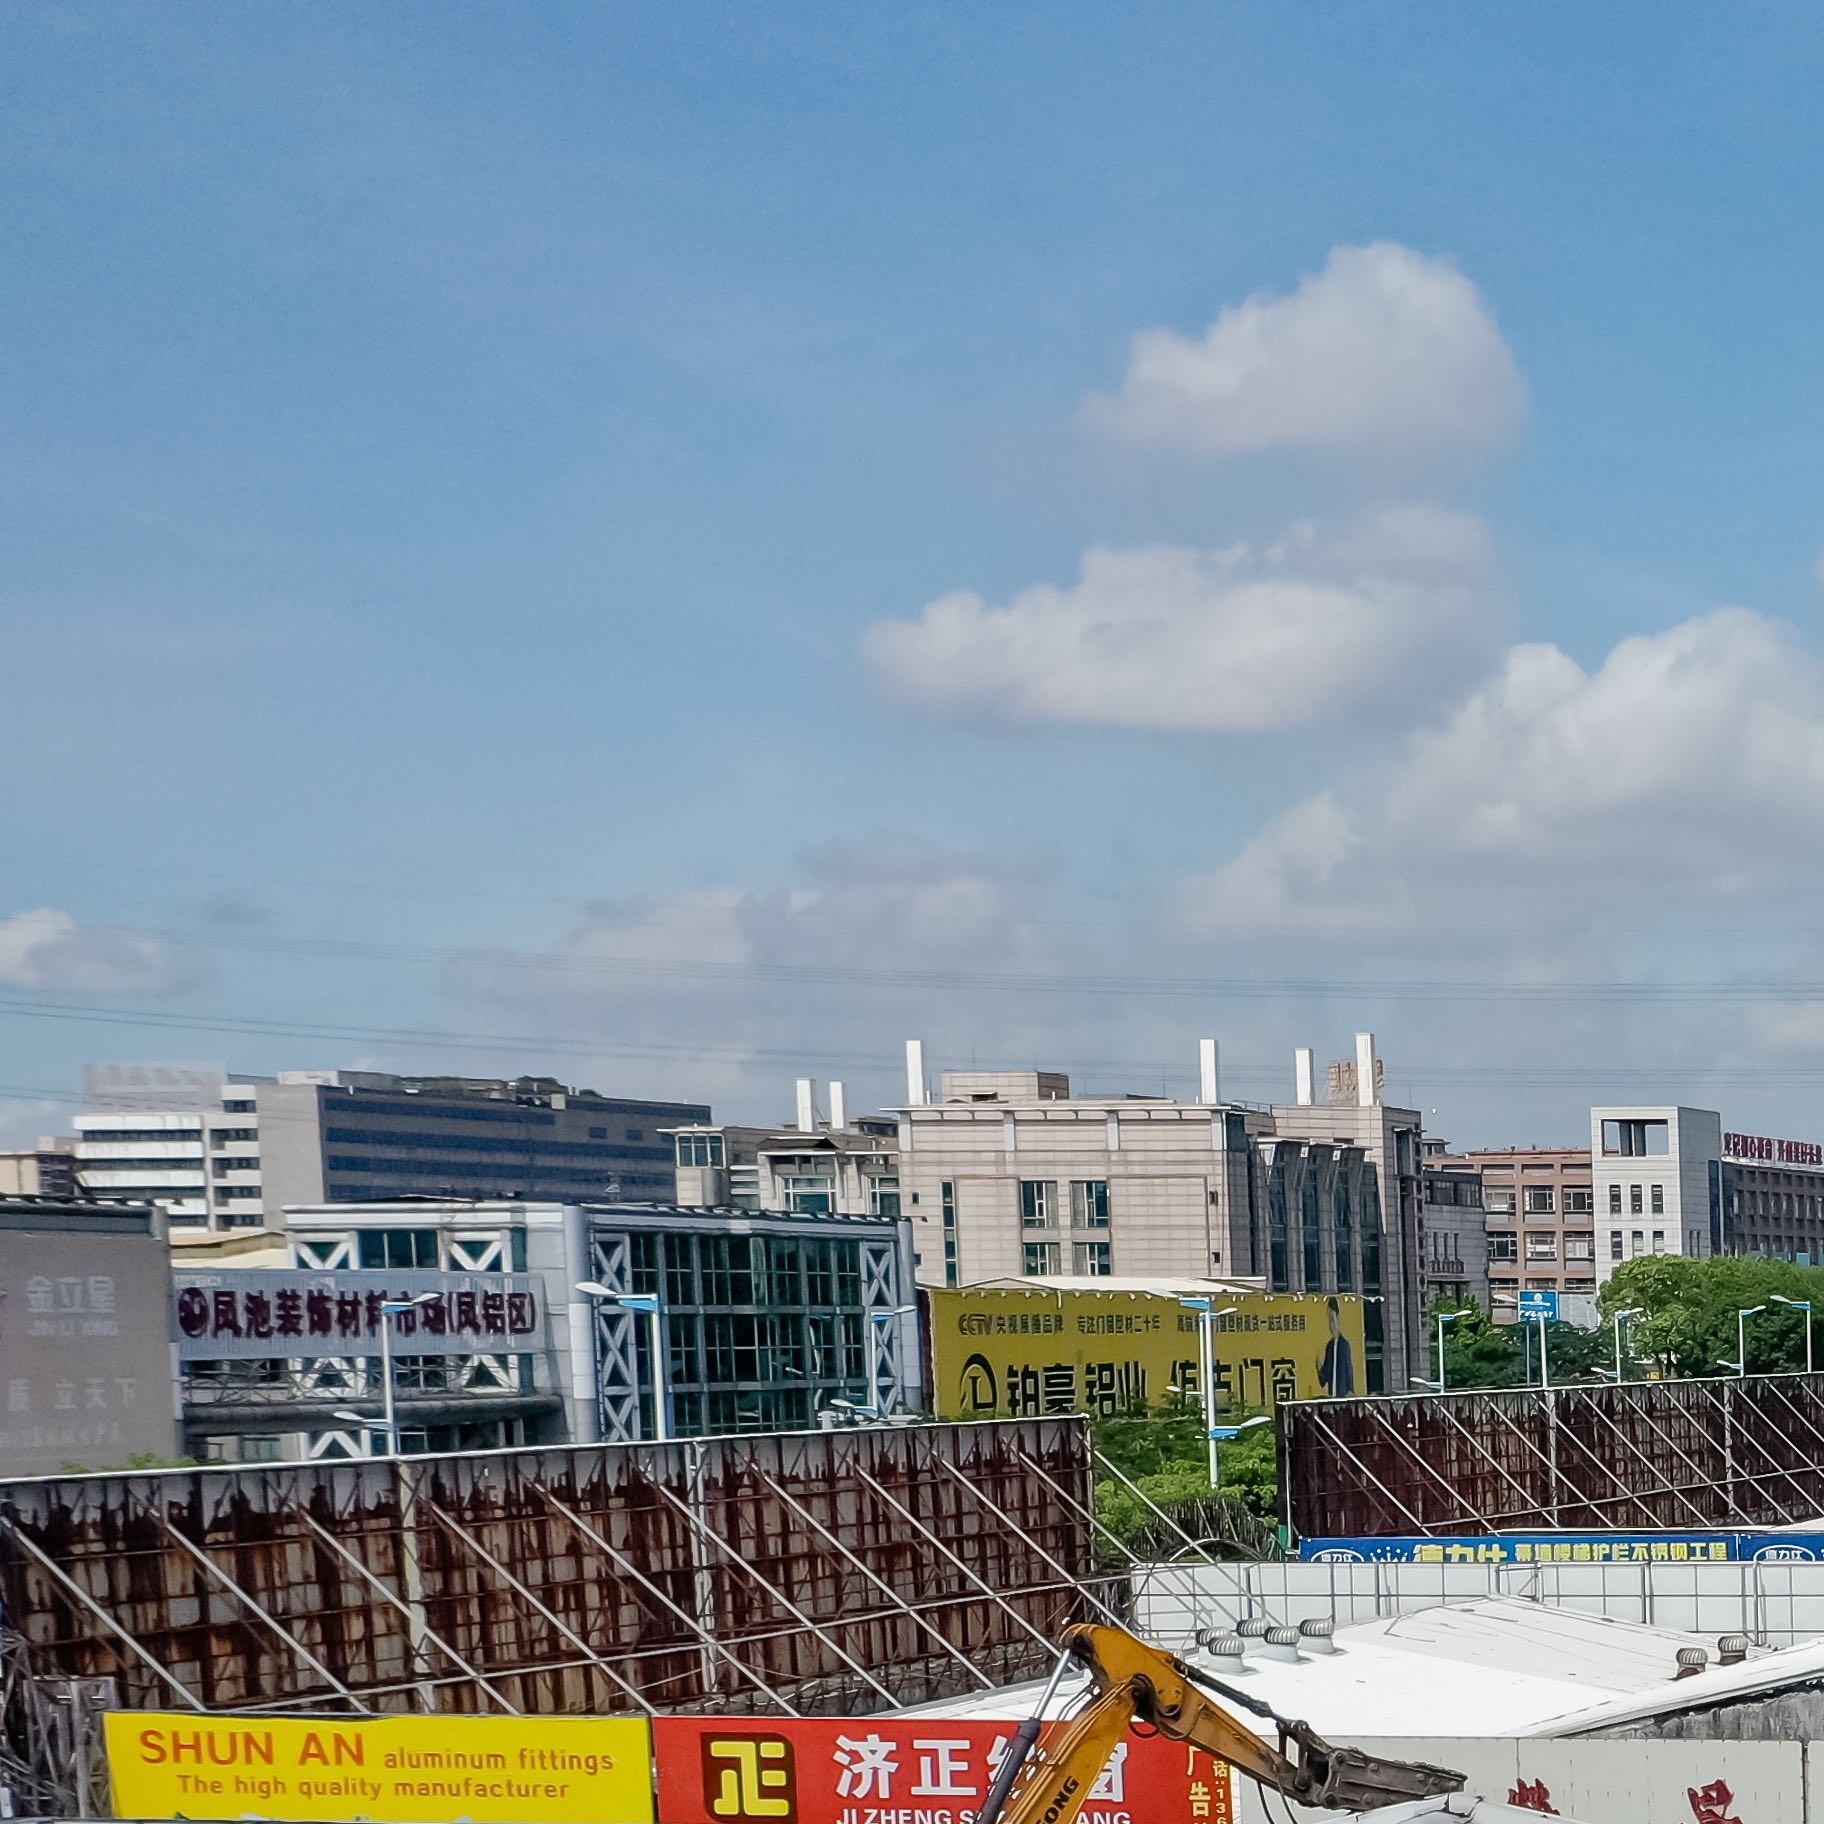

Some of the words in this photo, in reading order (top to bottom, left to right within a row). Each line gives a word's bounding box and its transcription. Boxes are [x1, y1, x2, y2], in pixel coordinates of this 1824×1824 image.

[140, 1730, 274, 1767] SHUN
[299, 1731, 365, 1766] AN
[384, 1745, 506, 1771] aluminum
[518, 1744, 614, 1775] fittings
[178, 1773, 224, 1797] The
[233, 1773, 287, 1801] high
[299, 1773, 382, 1801] quality
[393, 1775, 571, 1799] manufacturer
